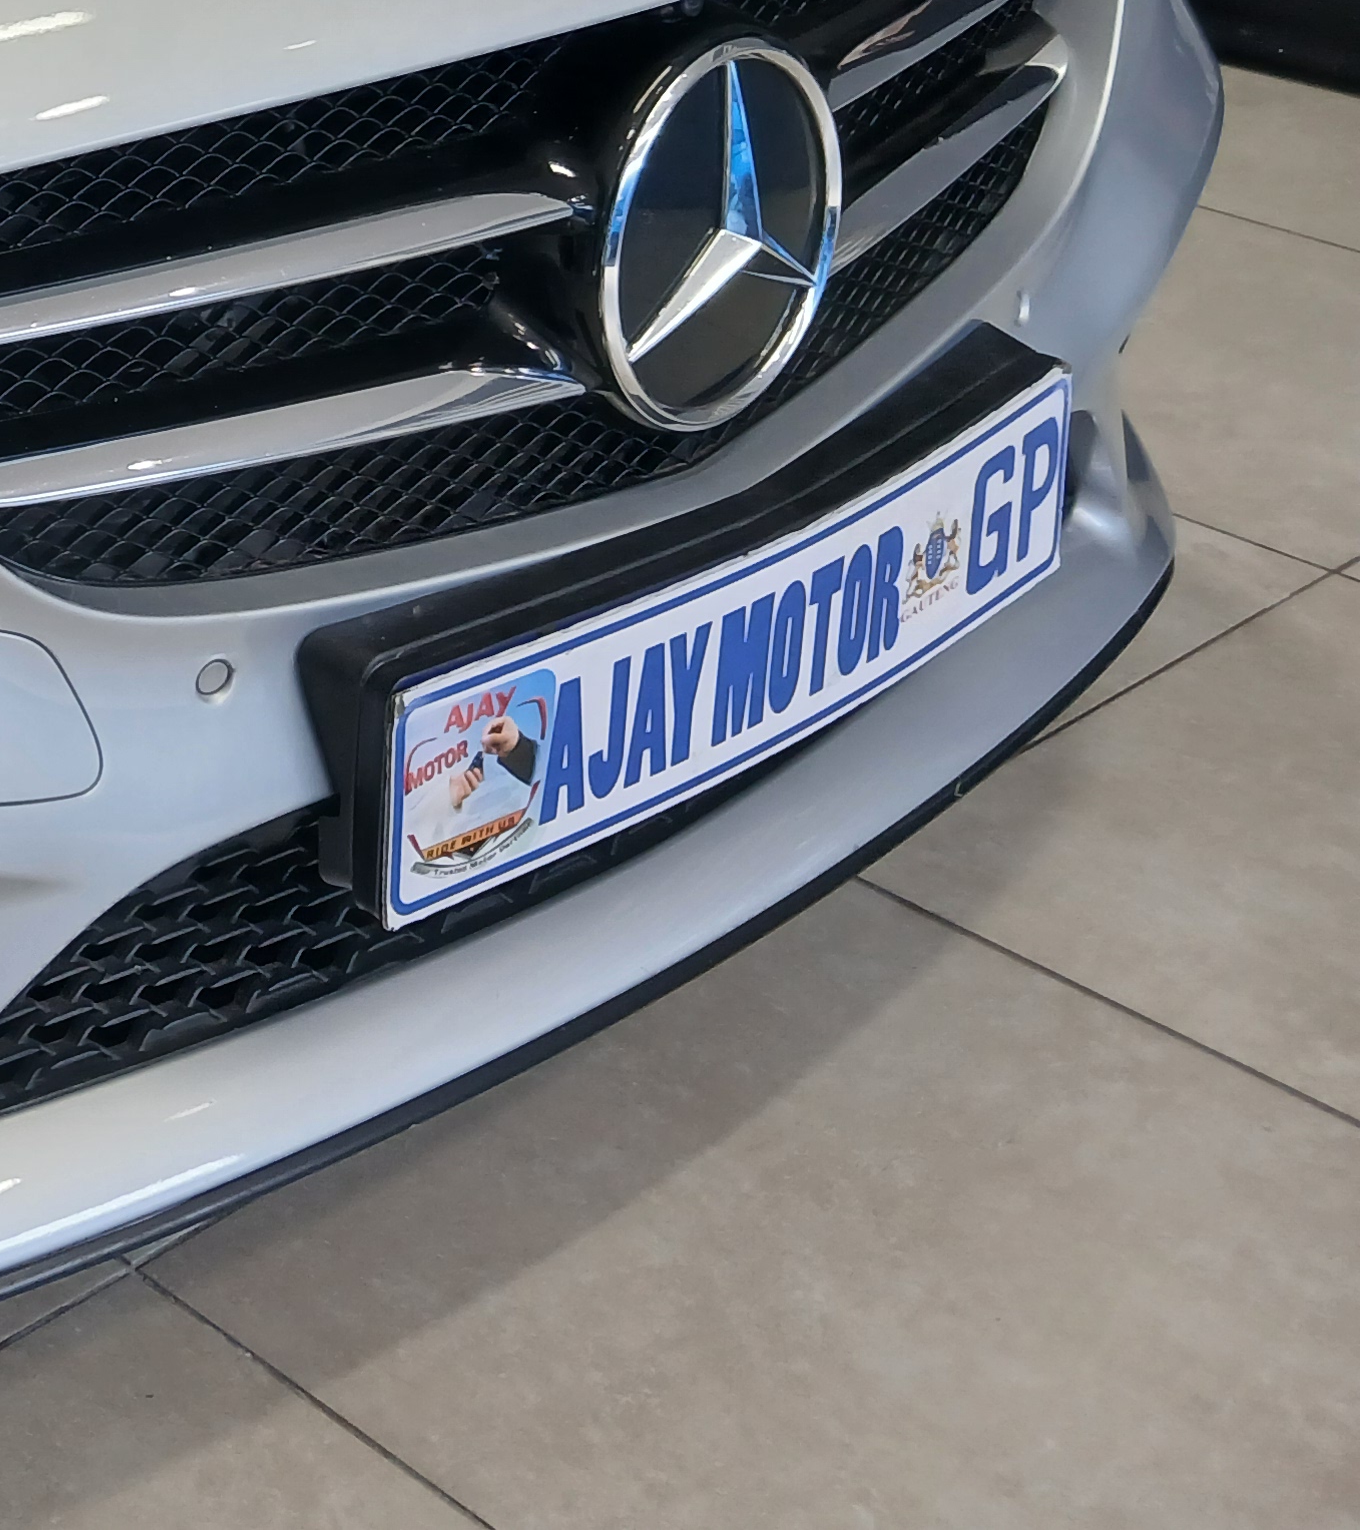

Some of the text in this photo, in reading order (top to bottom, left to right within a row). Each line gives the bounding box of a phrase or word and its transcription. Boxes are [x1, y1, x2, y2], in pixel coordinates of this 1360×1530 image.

[965, 415, 1061, 597] GP
[444, 686, 517, 734] AJAY
[404, 740, 469, 796] MOTOR
